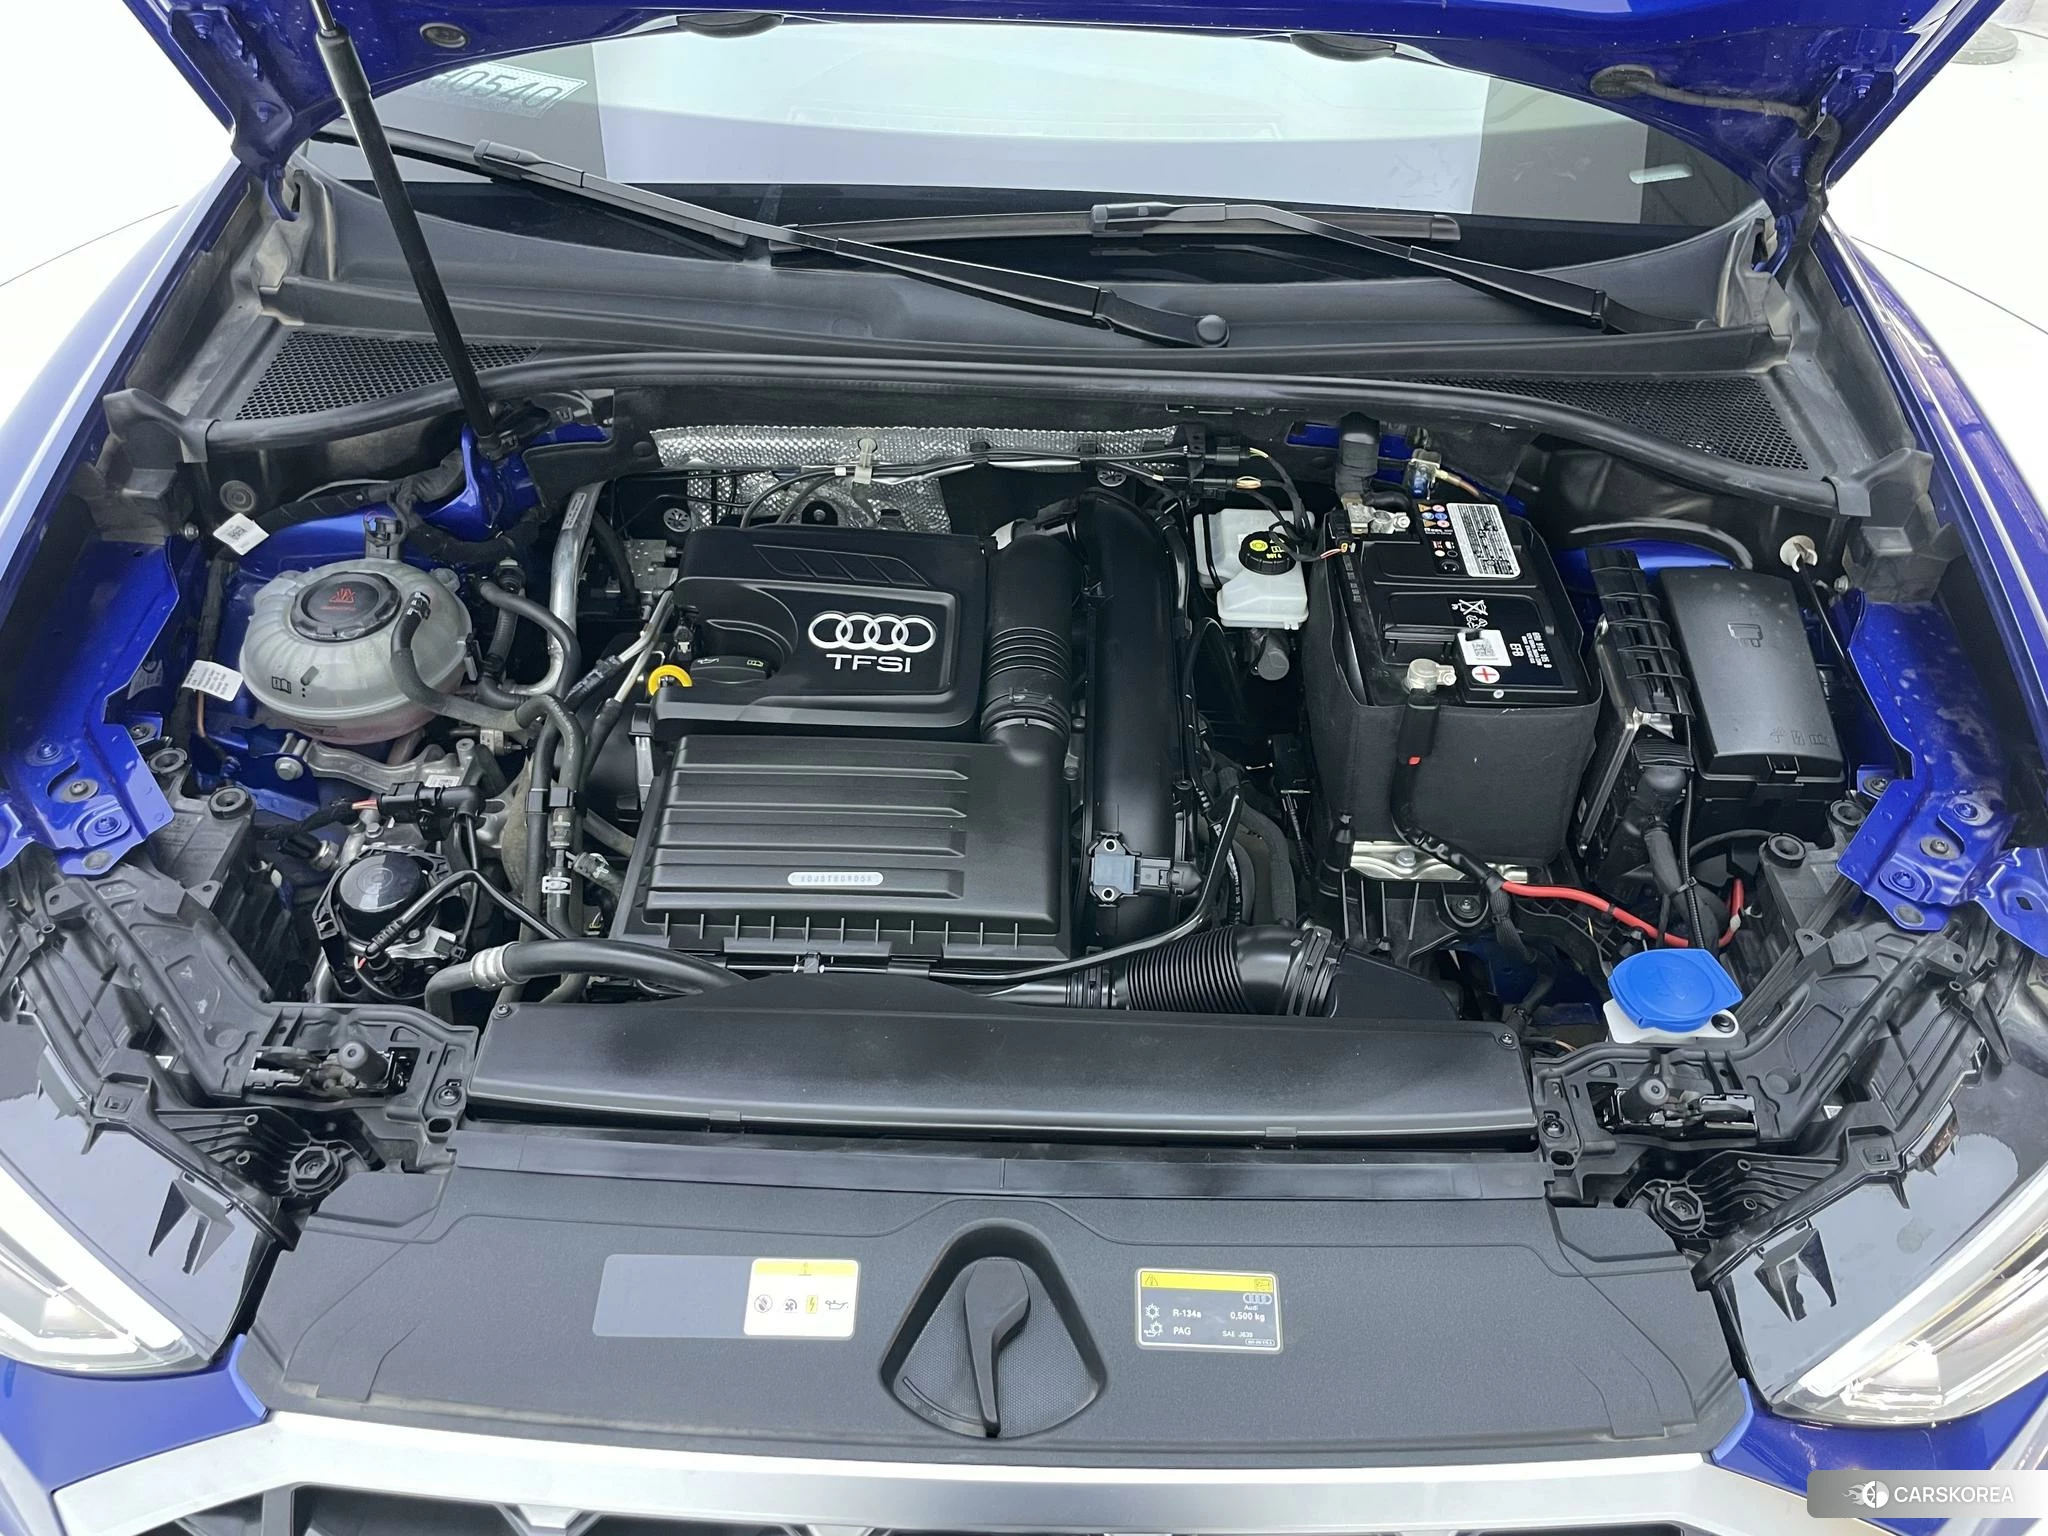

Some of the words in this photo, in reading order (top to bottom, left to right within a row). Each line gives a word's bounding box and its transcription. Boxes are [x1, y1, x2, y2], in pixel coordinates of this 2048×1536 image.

[1509, 643, 1525, 657] EFB
[826, 653, 912, 674] TFSI
[1244, 1304, 1259, 1312] Audi
[1172, 1308, 1202, 1319] R-134a
[1230, 1311, 1253, 1321] 0,500
[1254, 1312, 1266, 1323] kg
[1173, 1326, 1192, 1336] PAG
